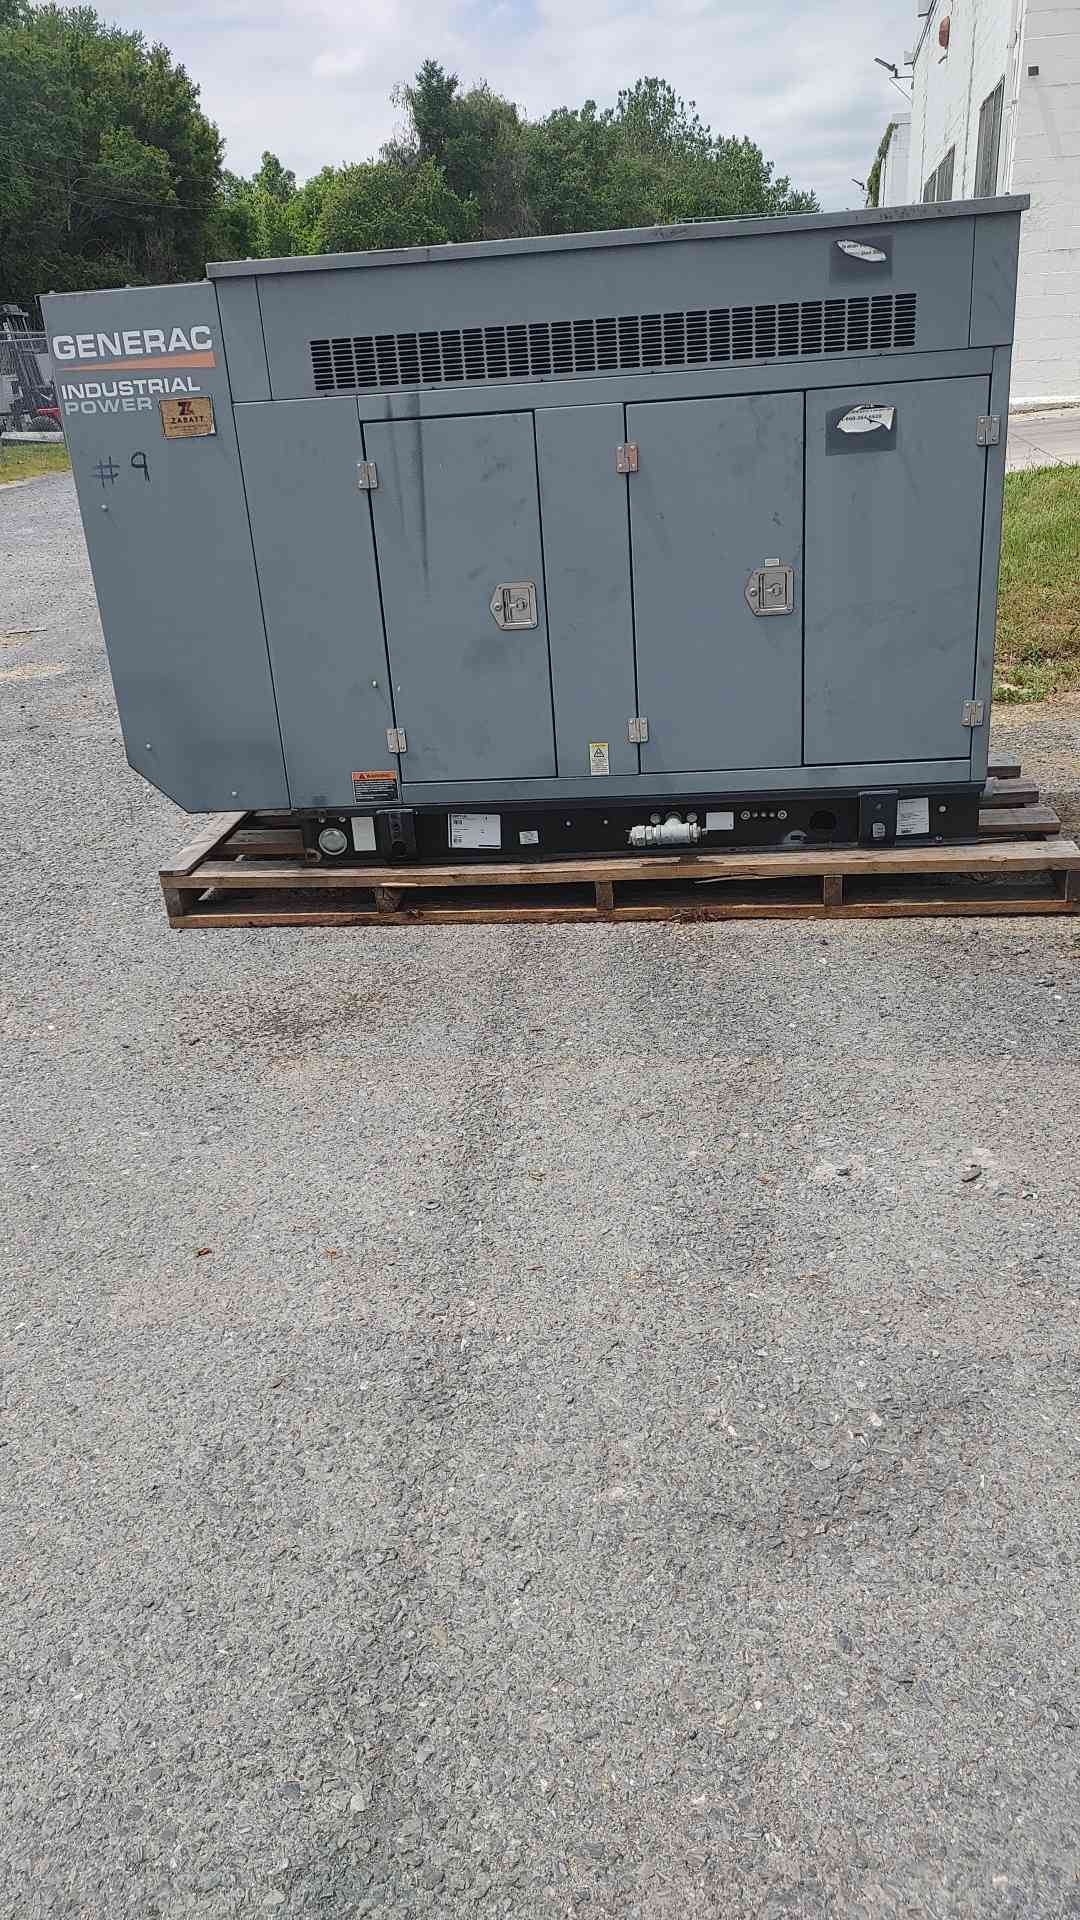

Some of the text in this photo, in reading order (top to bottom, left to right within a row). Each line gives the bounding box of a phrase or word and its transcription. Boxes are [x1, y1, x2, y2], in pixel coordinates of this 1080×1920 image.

[53, 326, 212, 359] GENERAC
[61, 377, 200, 399] INDUSTRIAL
[65, 397, 152, 415] POWER
